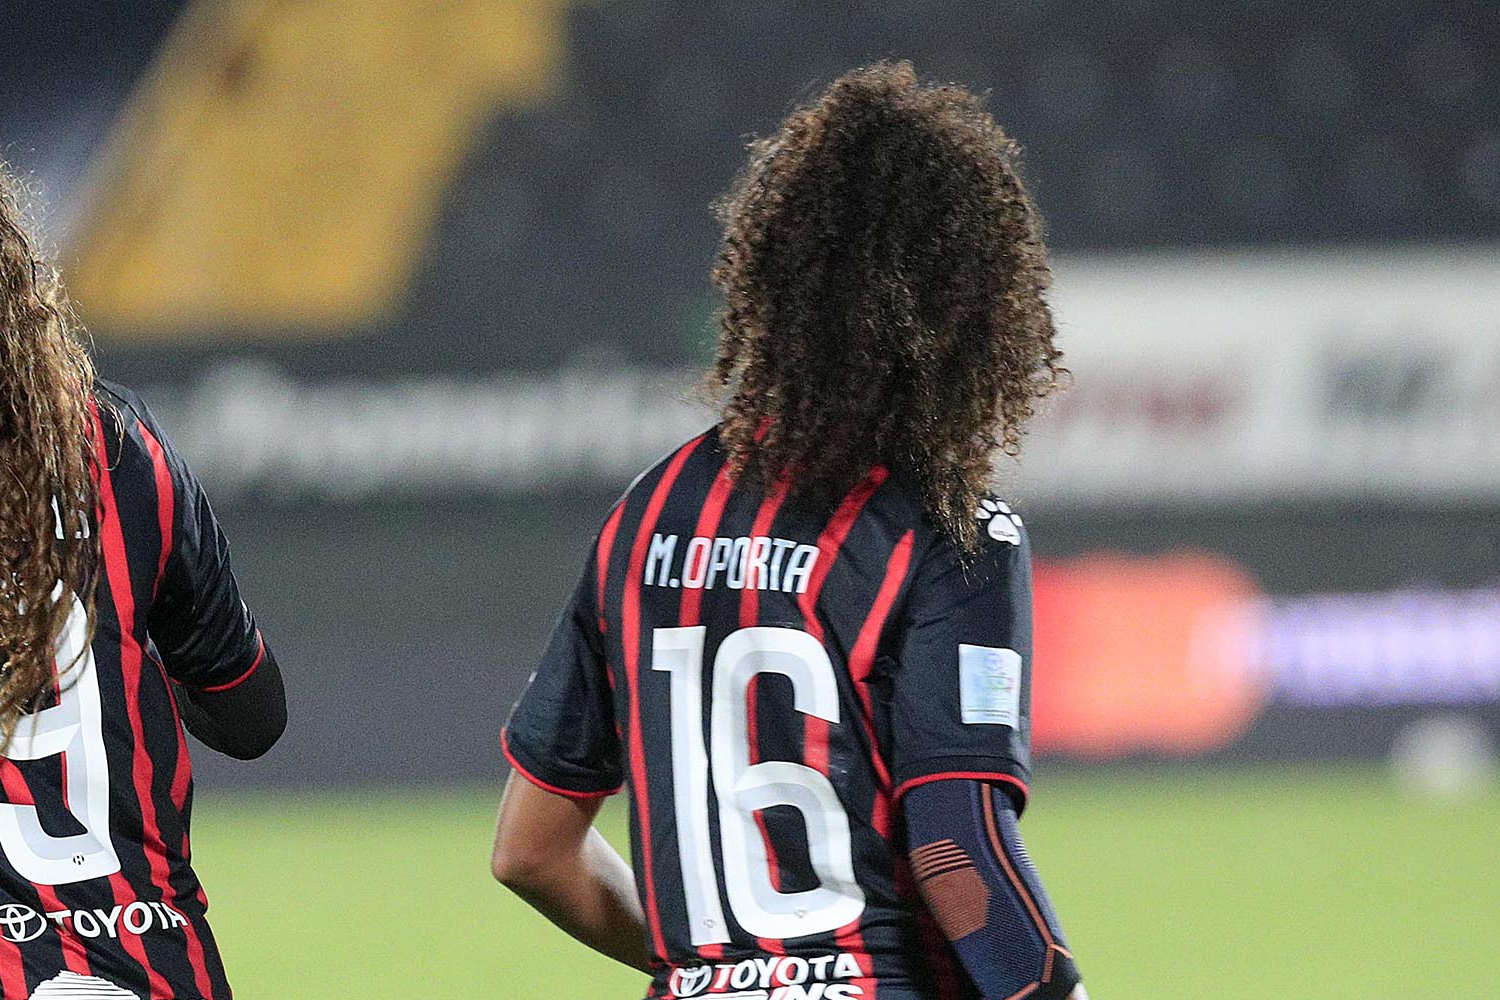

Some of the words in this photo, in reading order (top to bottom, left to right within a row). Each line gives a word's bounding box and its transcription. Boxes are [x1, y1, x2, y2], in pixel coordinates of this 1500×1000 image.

[644, 533, 820, 594] M.OPORTA
[652, 626, 866, 945] 16
[47, 901, 189, 938] TOYOTA
[713, 953, 864, 990] TOYOTA
